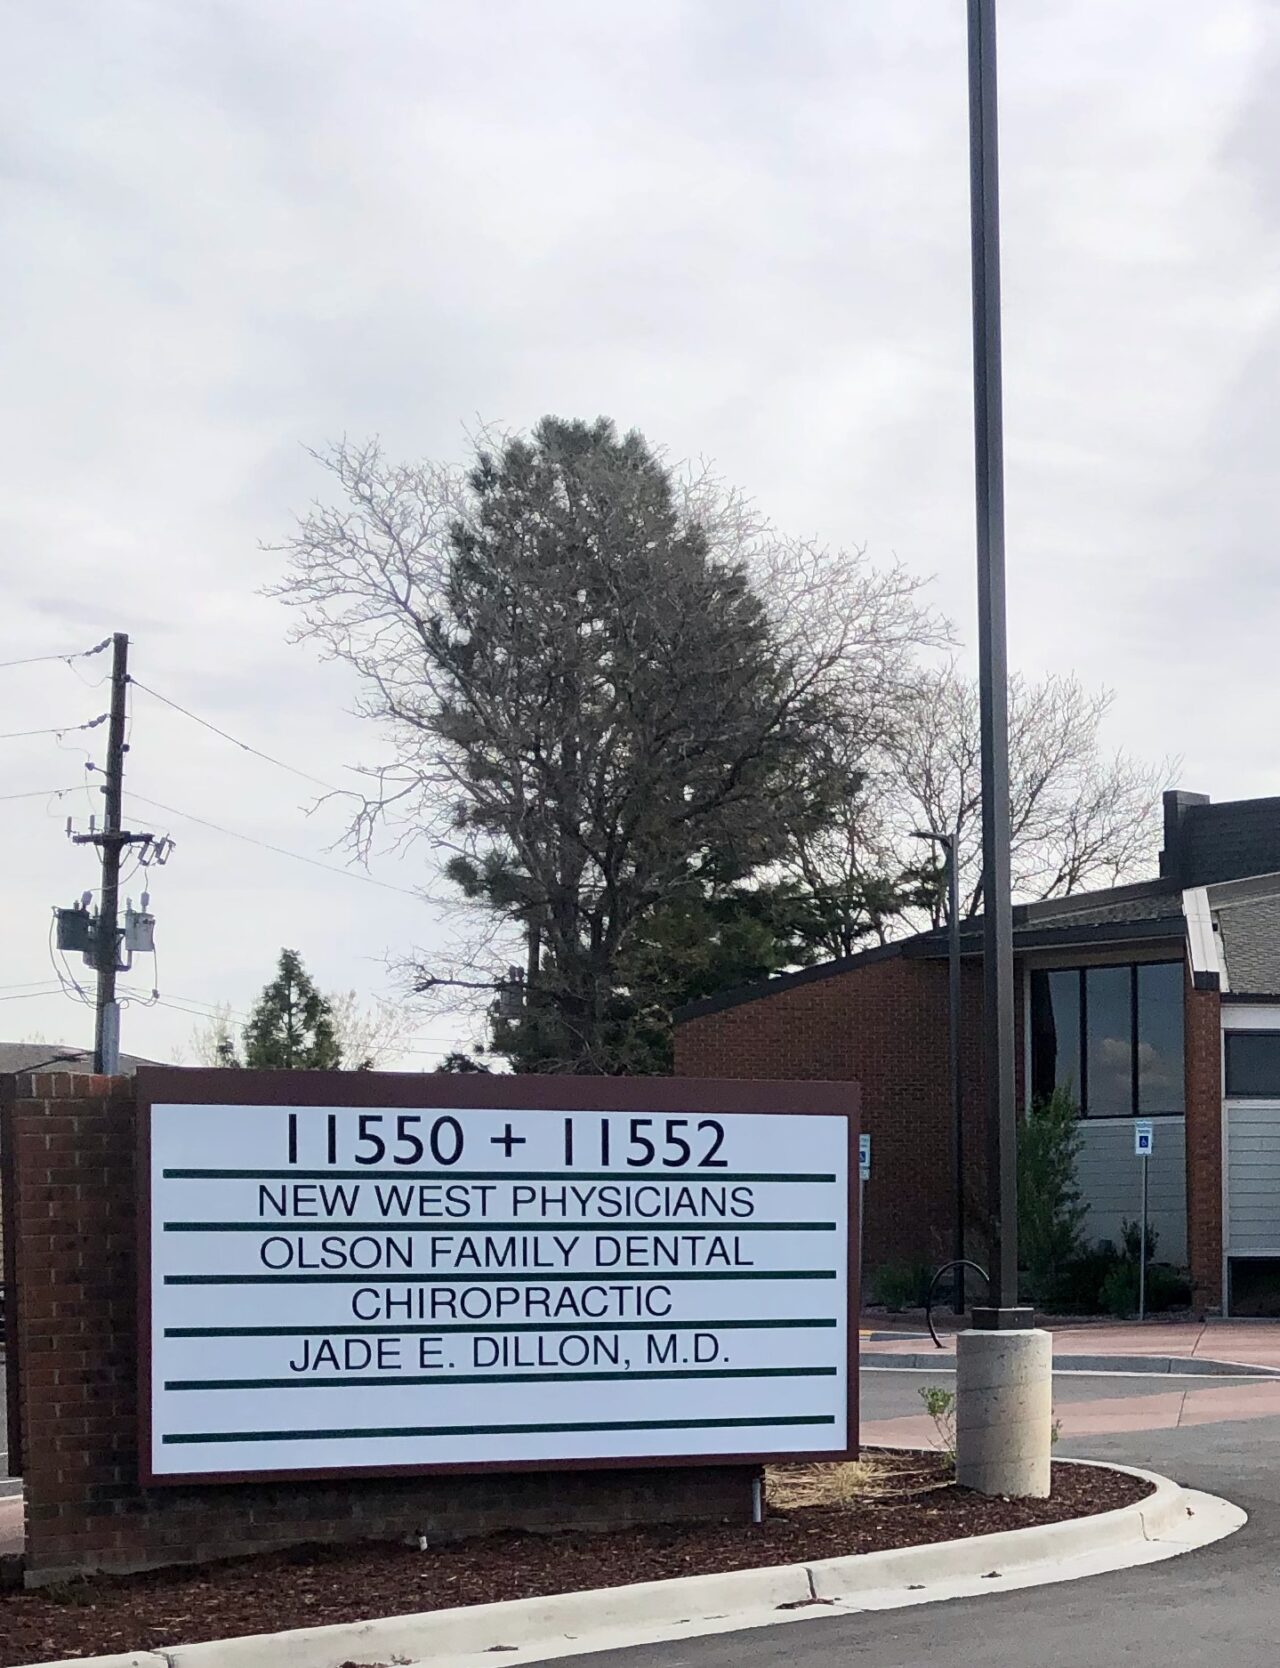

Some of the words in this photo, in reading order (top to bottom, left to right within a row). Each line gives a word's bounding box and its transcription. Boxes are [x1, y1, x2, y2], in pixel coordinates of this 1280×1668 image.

[287, 1113, 465, 1165] 11550
[489, 1122, 527, 1159] +
[562, 1117, 729, 1168] 11552
[258, 1185, 361, 1217] NEW
[374, 1185, 497, 1217] WEST
[511, 1185, 755, 1218] PHYSICIANS
[260, 1235, 414, 1270] OLSON
[430, 1236, 580, 1268] FAMILY
[595, 1235, 754, 1267] DENTAL
[351, 1285, 673, 1321] CHIROPRACTIC
[289, 1338, 402, 1372] JADE
[419, 1337, 456, 1369] E.
[473, 1335, 631, 1371] DILLON,
[647, 1333, 730, 1364] M.D.
